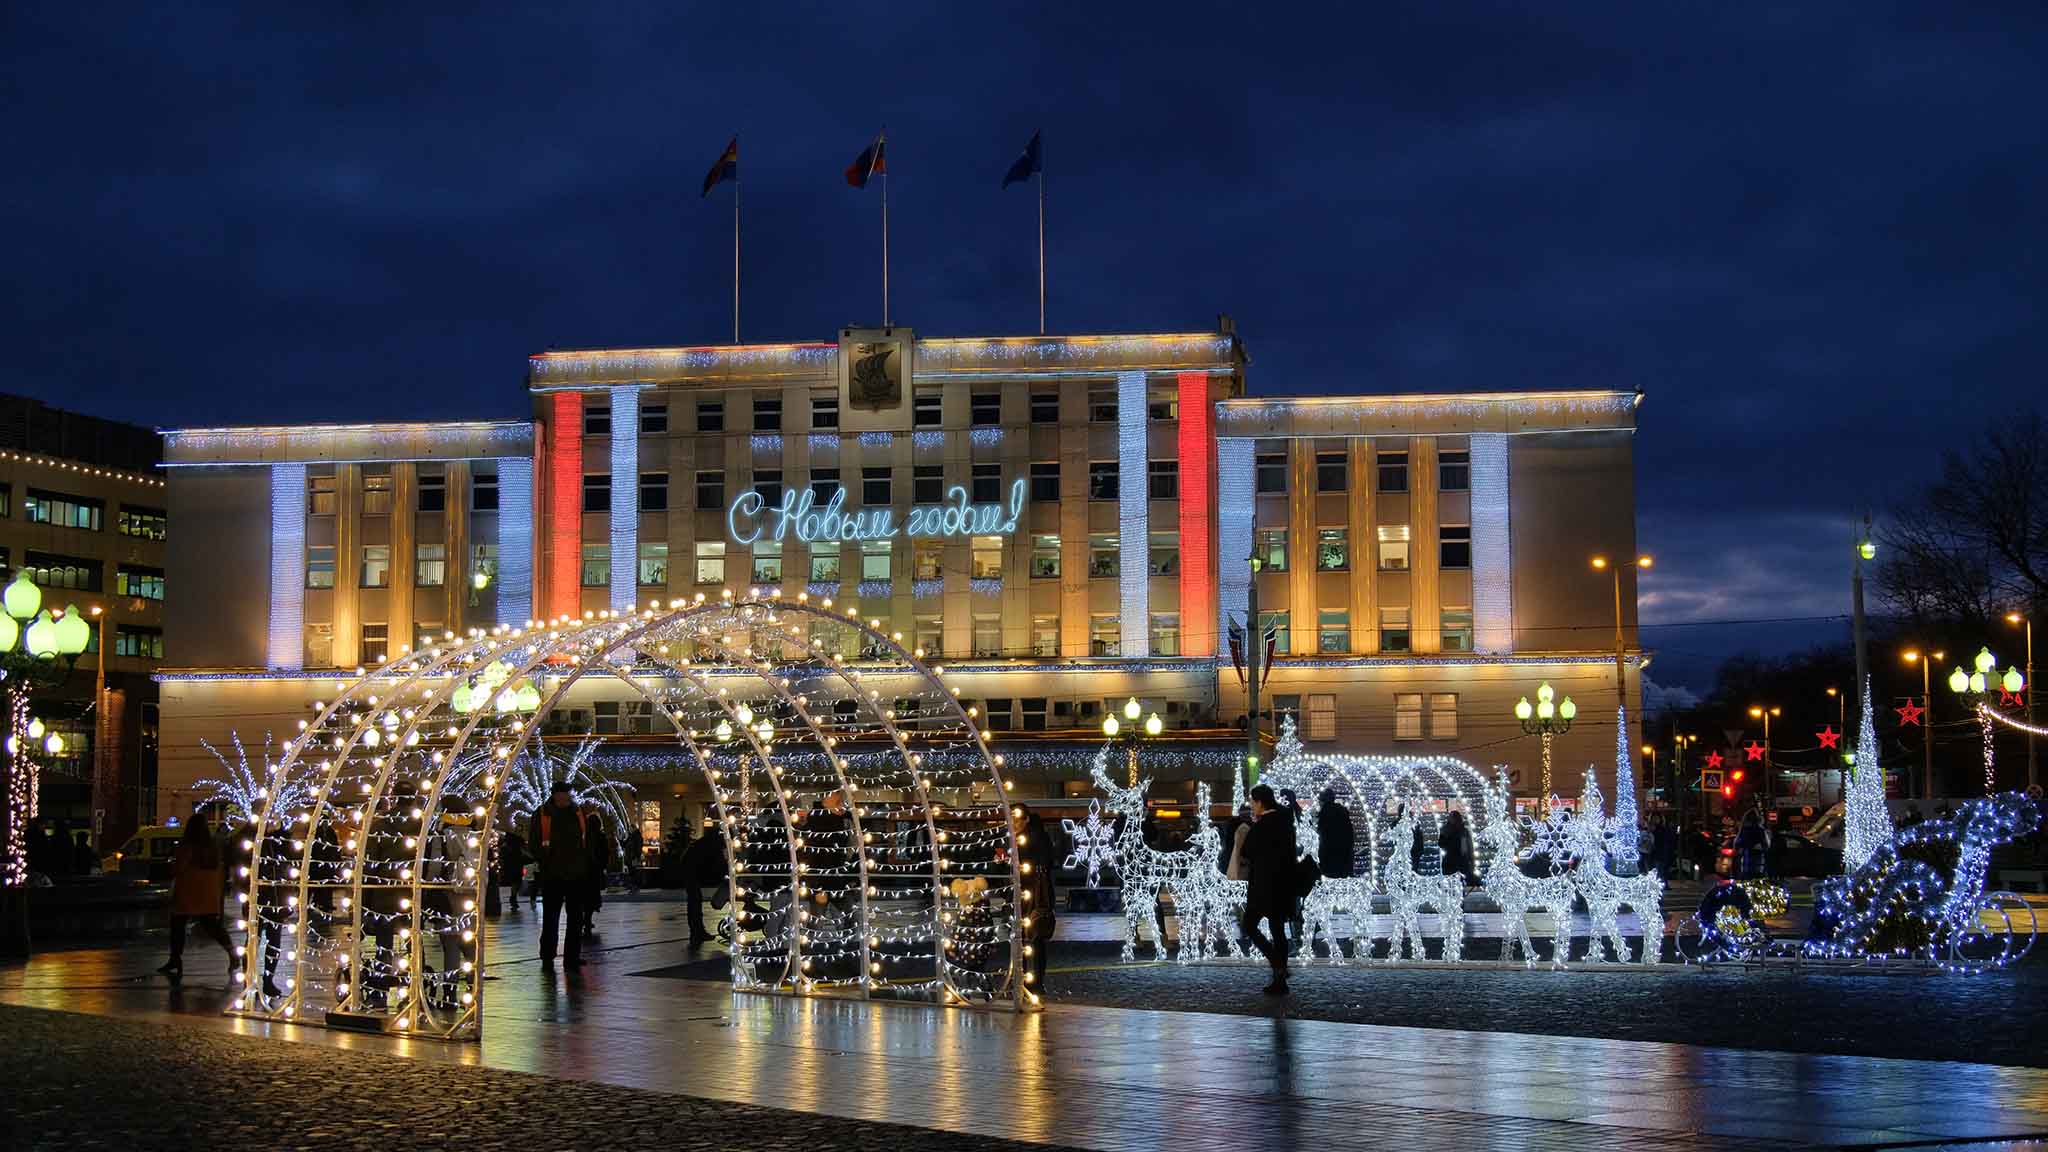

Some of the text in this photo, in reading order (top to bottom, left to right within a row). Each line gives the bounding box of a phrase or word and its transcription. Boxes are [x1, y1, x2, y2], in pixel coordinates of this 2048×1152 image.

[730, 478, 1025, 544] С Новым годом!
